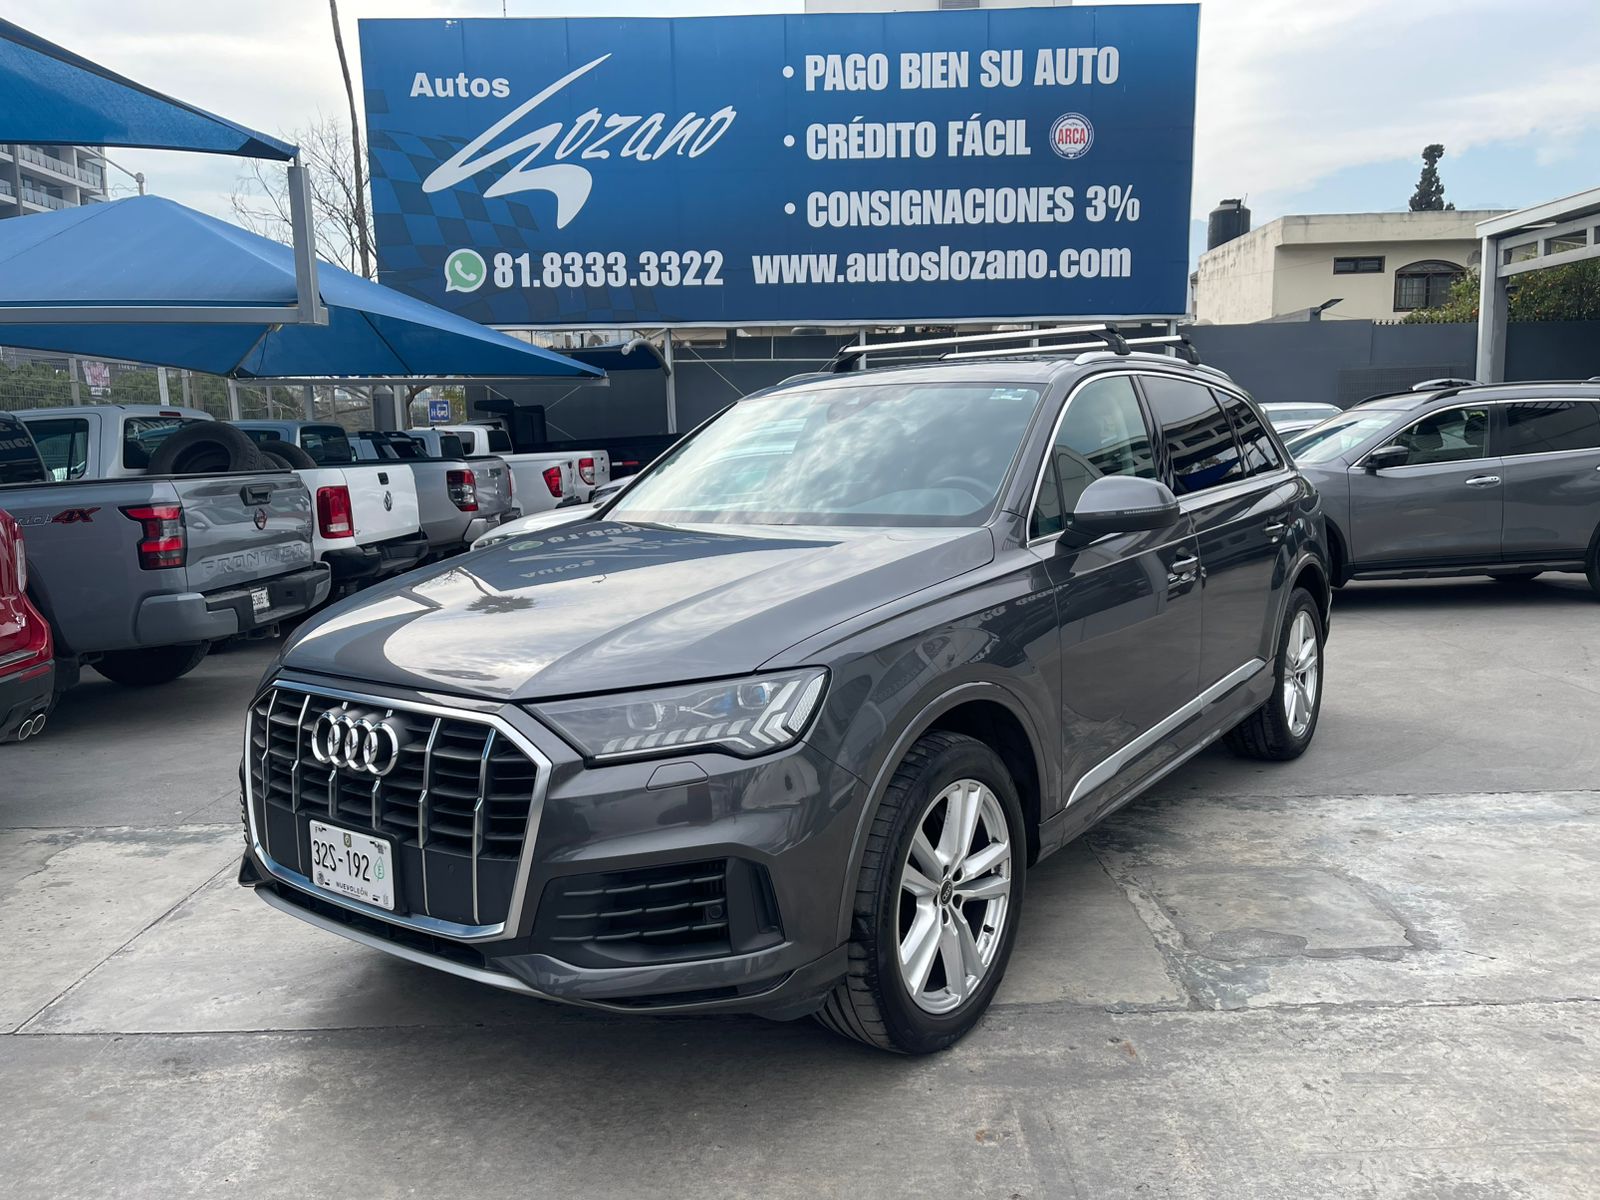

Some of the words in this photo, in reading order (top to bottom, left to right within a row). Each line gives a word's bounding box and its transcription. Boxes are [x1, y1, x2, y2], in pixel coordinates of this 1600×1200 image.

[410, 72, 511, 98] Autos
[805, 53, 889, 91] PAGO
[900, 50, 969, 90] BIEN
[980, 49, 1023, 87] SU
[1033, 46, 1120, 86] AUTO
[806, 115, 937, 160] CRÉDITO
[947, 112, 1032, 157] FÁCIL
[1058, 127, 1086, 145] ARCA
[806, 186, 1075, 228] CONSIGNACIONES
[1085, 184, 1141, 222] 3%
[493, 250, 724, 288] 81.8333.3322
[751, 245, 1132, 285] www.autoslozano.com
[201, 543, 306, 576] FRONTIER
[313, 839, 371, 882] 32S-192
